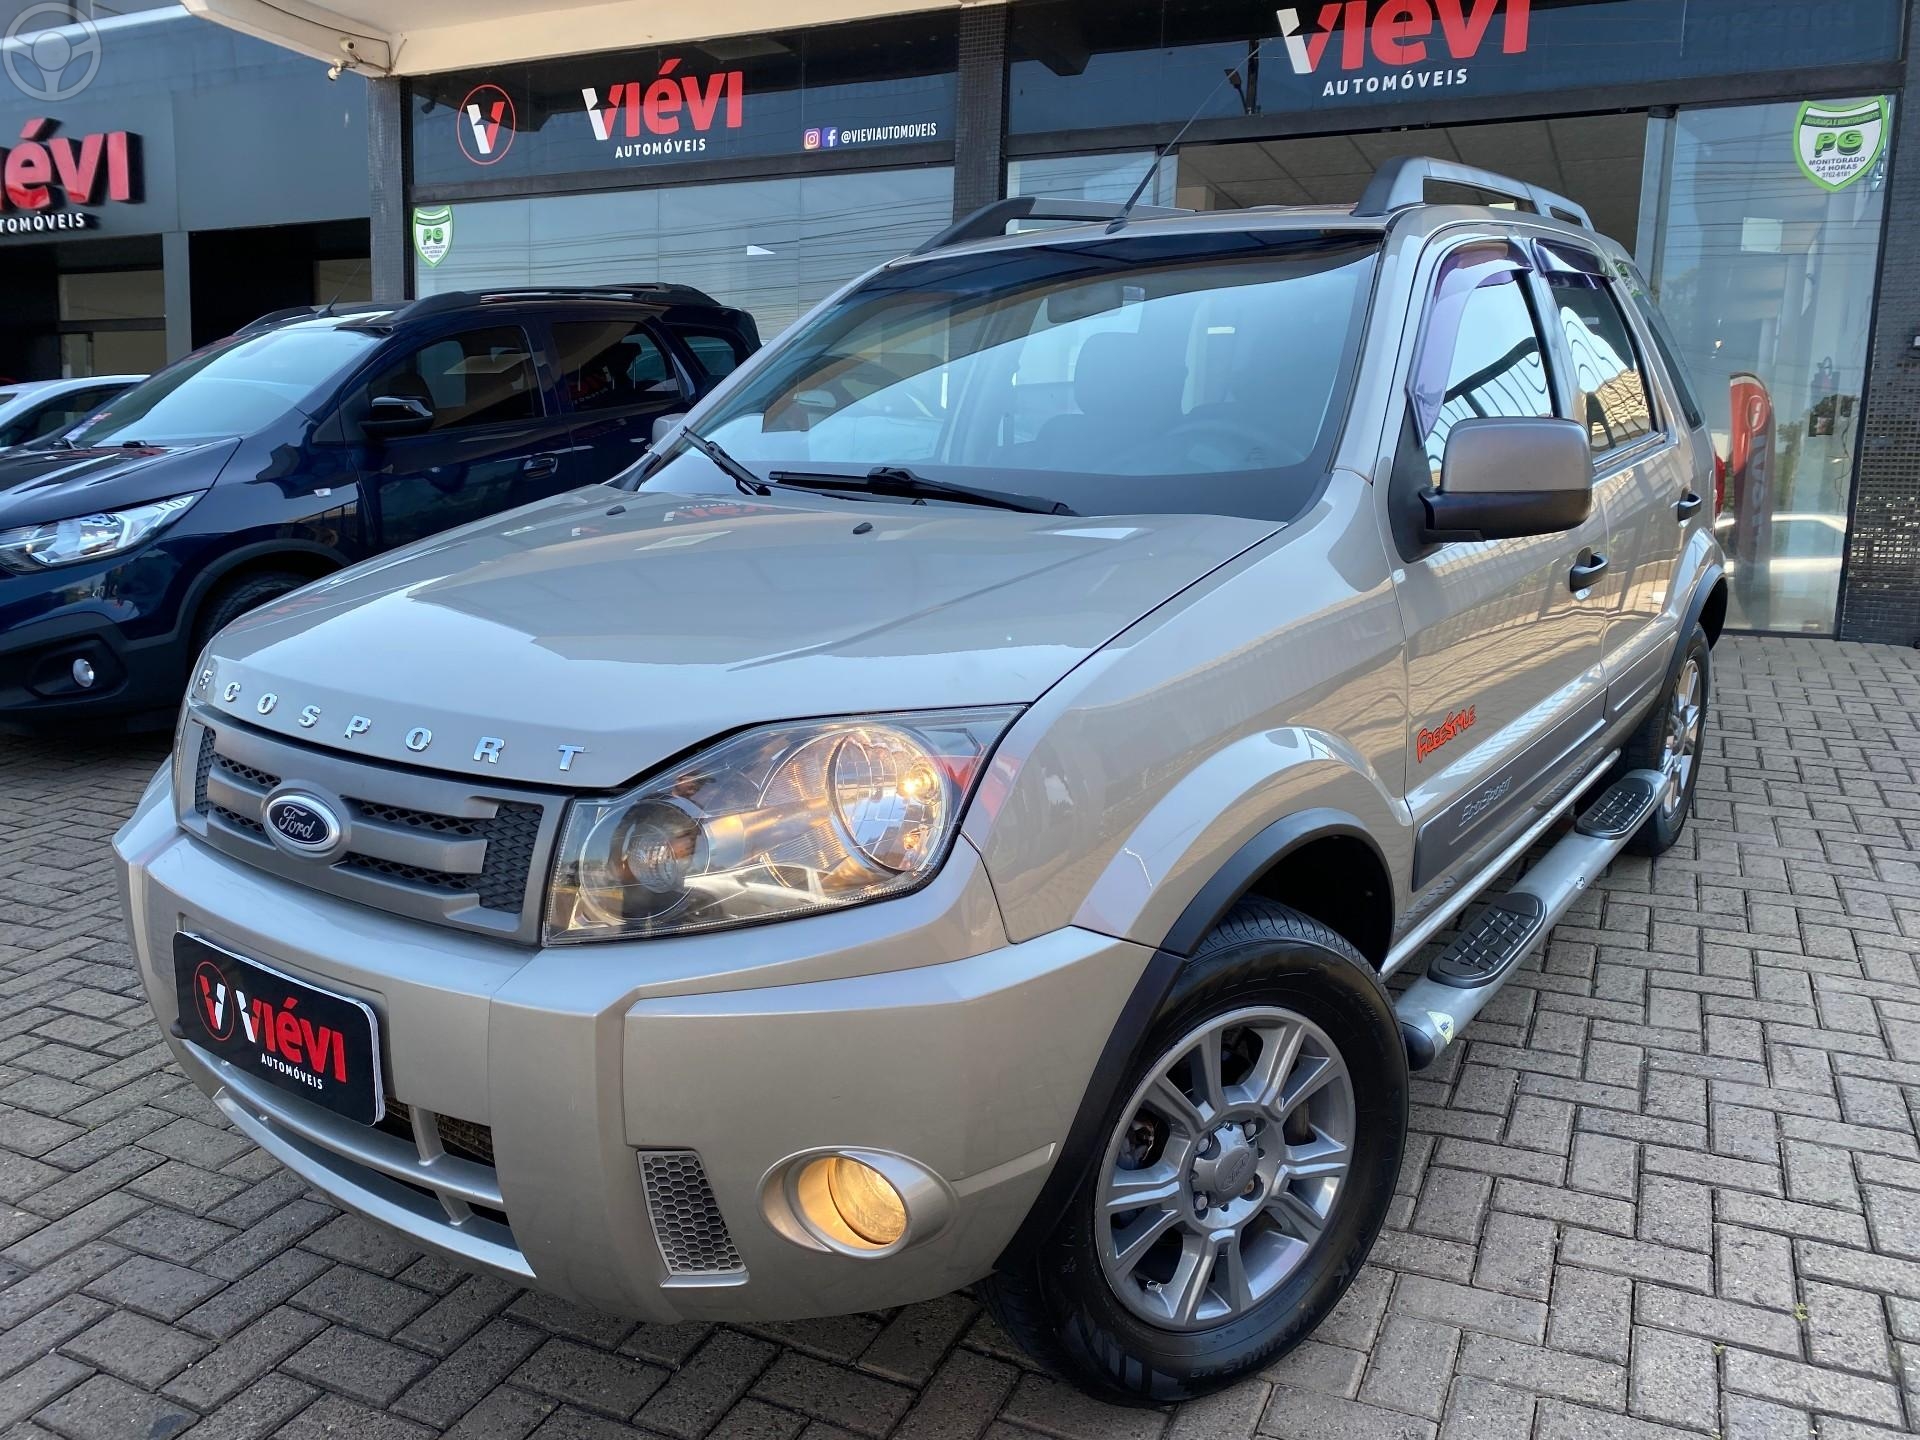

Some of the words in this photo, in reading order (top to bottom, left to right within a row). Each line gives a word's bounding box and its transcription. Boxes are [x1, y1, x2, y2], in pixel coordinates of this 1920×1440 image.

[1322, 68, 1468, 97] AUTOMÓVEIS
[841, 122, 937, 144] @VIEVIAUTOMOVEIS
[615, 138, 706, 159] AUTOMÓVEIS
[1808, 156, 1866, 166] MONITORADO
[1828, 163, 1858, 171] HORAS
[199, 669, 586, 772] ECOSPORT
[277, 804, 316, 840] Ford
[261, 1053, 324, 1091] AUTOMÓVEIS
